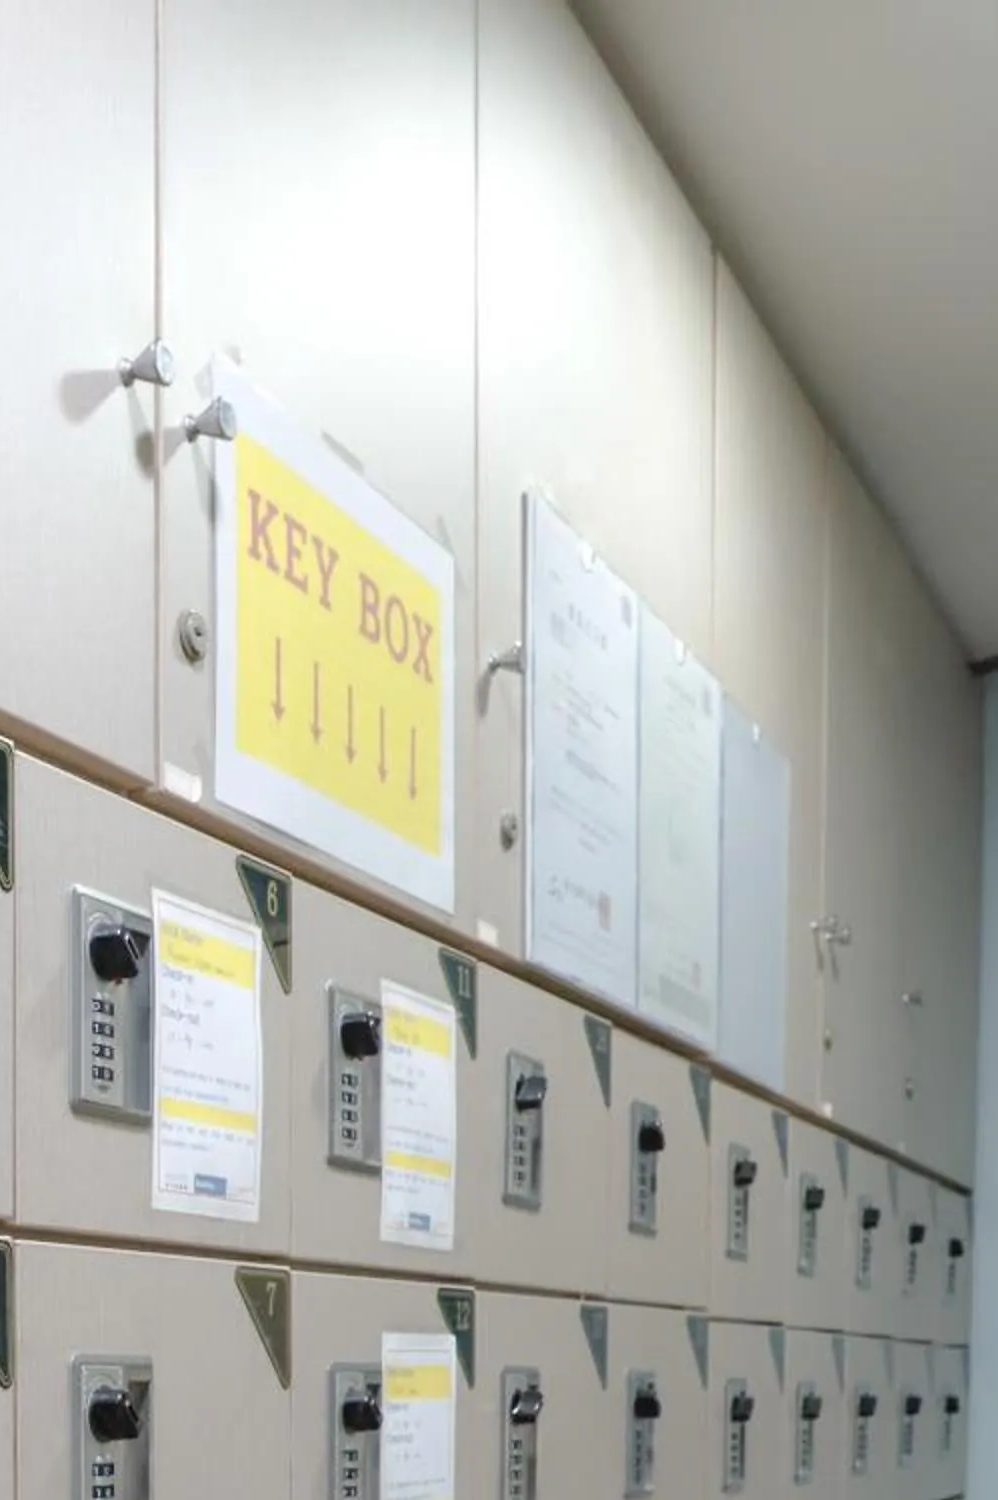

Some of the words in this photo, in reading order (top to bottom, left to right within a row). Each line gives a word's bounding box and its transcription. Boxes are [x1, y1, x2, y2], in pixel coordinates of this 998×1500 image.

[246, 486, 340, 612] KEY
[358, 571, 435, 685] BOX
[267, 881, 279, 917] 6
[456, 966, 472, 999] 11
[266, 1281, 277, 1317] 7
